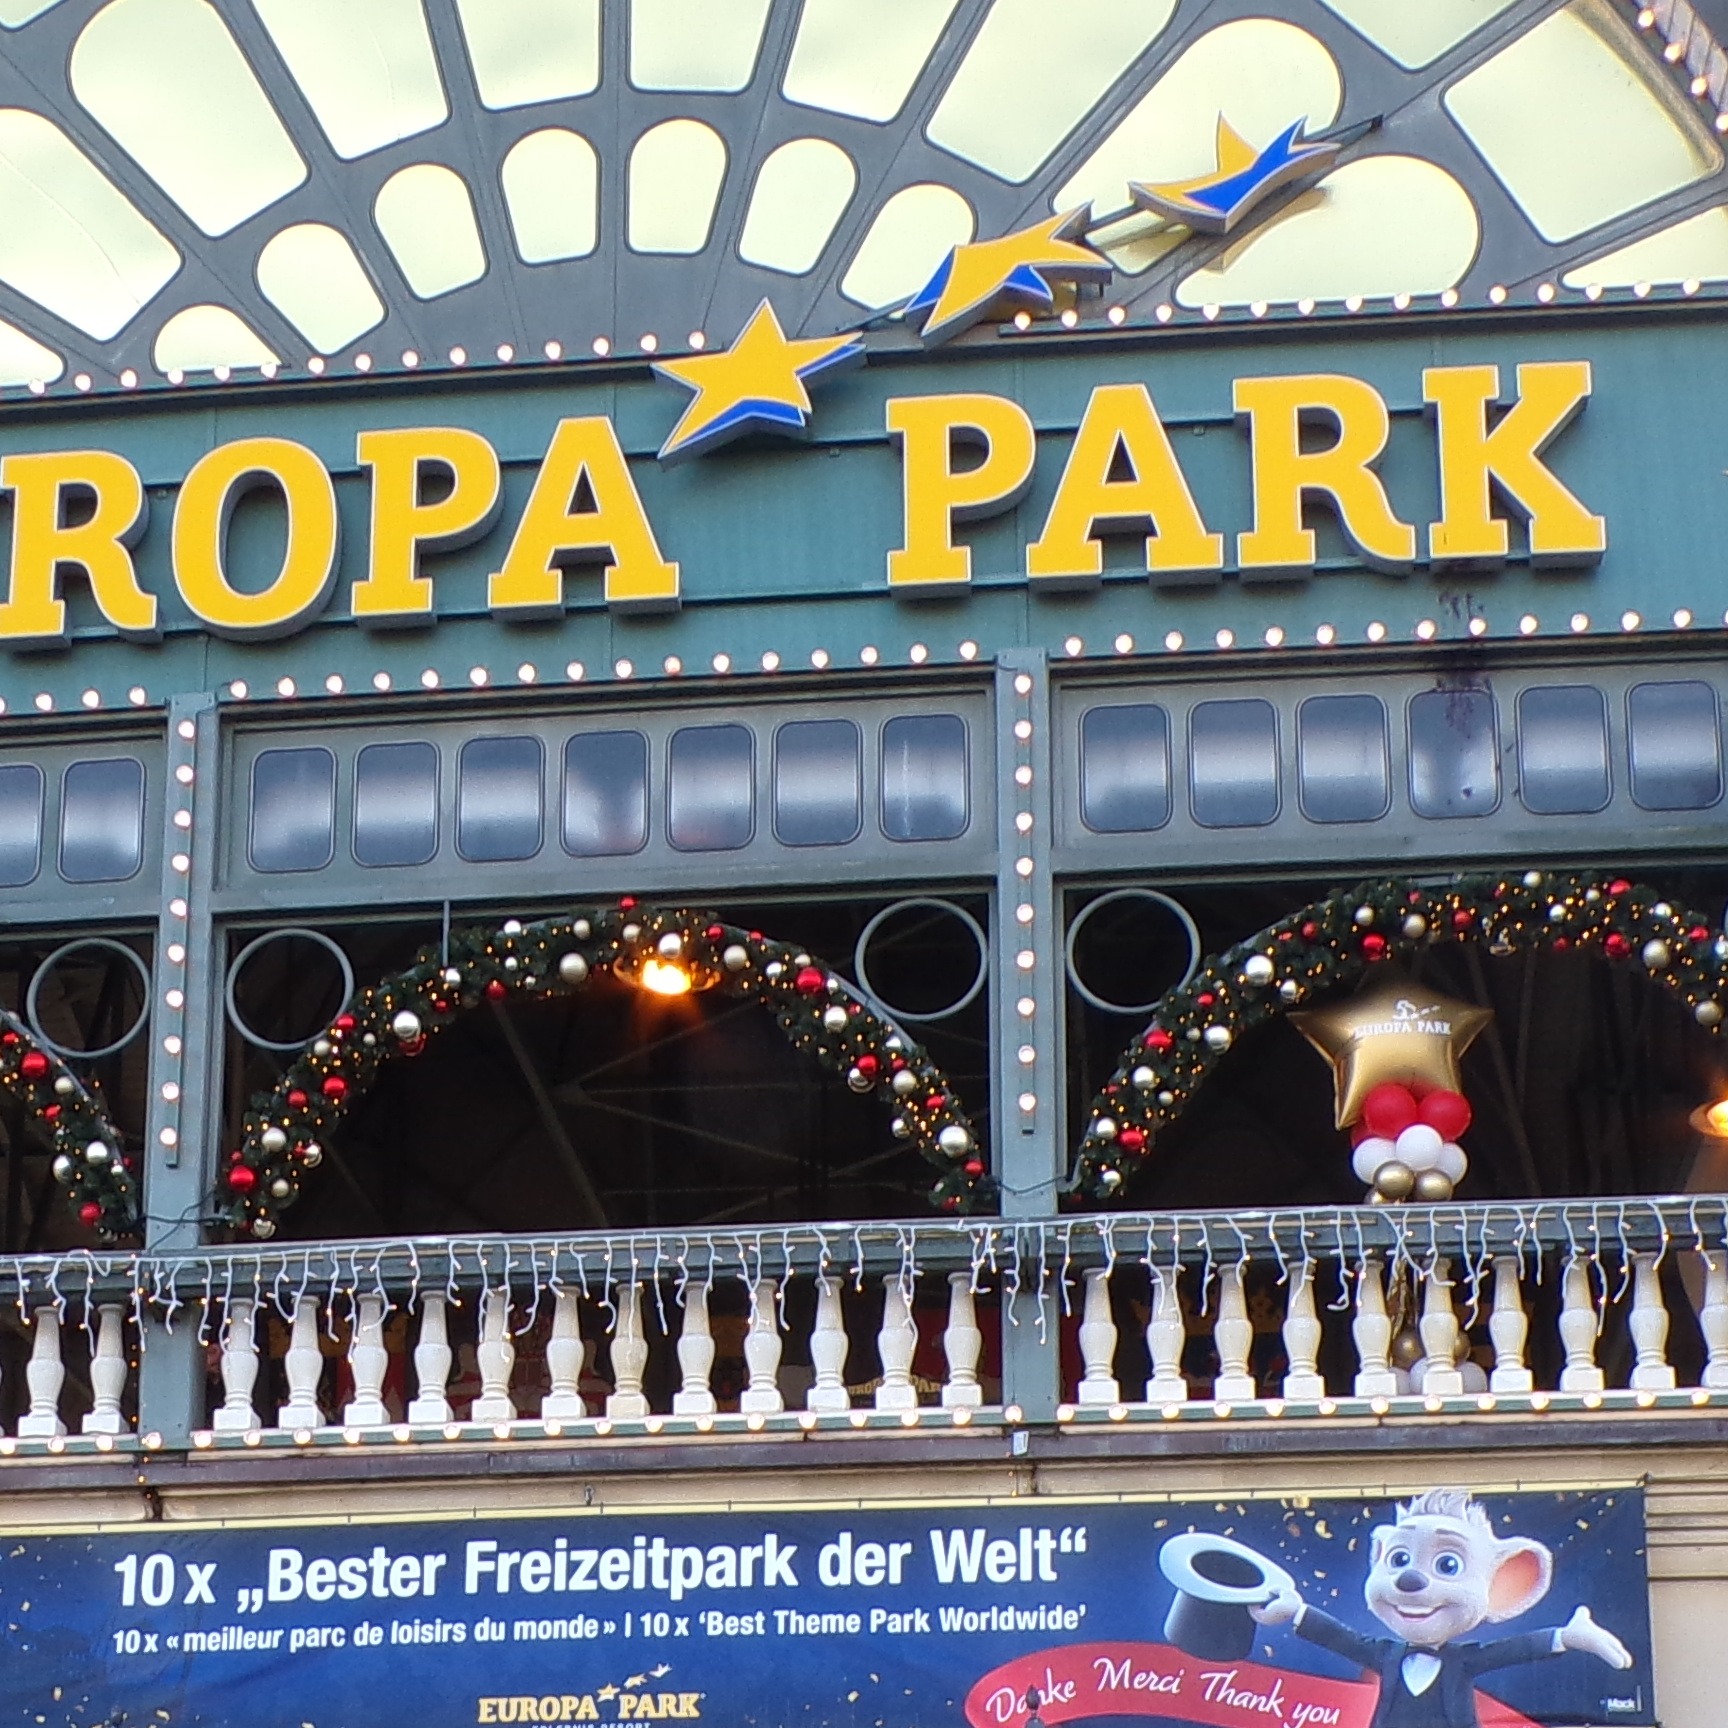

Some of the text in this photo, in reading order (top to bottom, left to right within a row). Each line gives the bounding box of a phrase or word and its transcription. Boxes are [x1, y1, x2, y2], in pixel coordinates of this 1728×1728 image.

[887, 362, 1608, 600] PARK
[1417, 1020, 1452, 1035] PARK
[237, 1546, 447, 1614] „Bester
[465, 1533, 799, 1601] Freizeitpark
[818, 1531, 913, 1587] der
[929, 1526, 1087, 1583] Welt“
[290, 1627, 346, 1653] parc
[353, 1621, 384, 1647] de
[390, 1618, 467, 1644] loisirs
[473, 1616, 506, 1642] du
[773, 1609, 861, 1635] Theme
[870, 1607, 931, 1633] Park
[477, 1692, 701, 1724] EUROPA PARK
[1092, 1657, 1186, 1695] Merci
[1199, 1669, 1284, 1718] Thank
